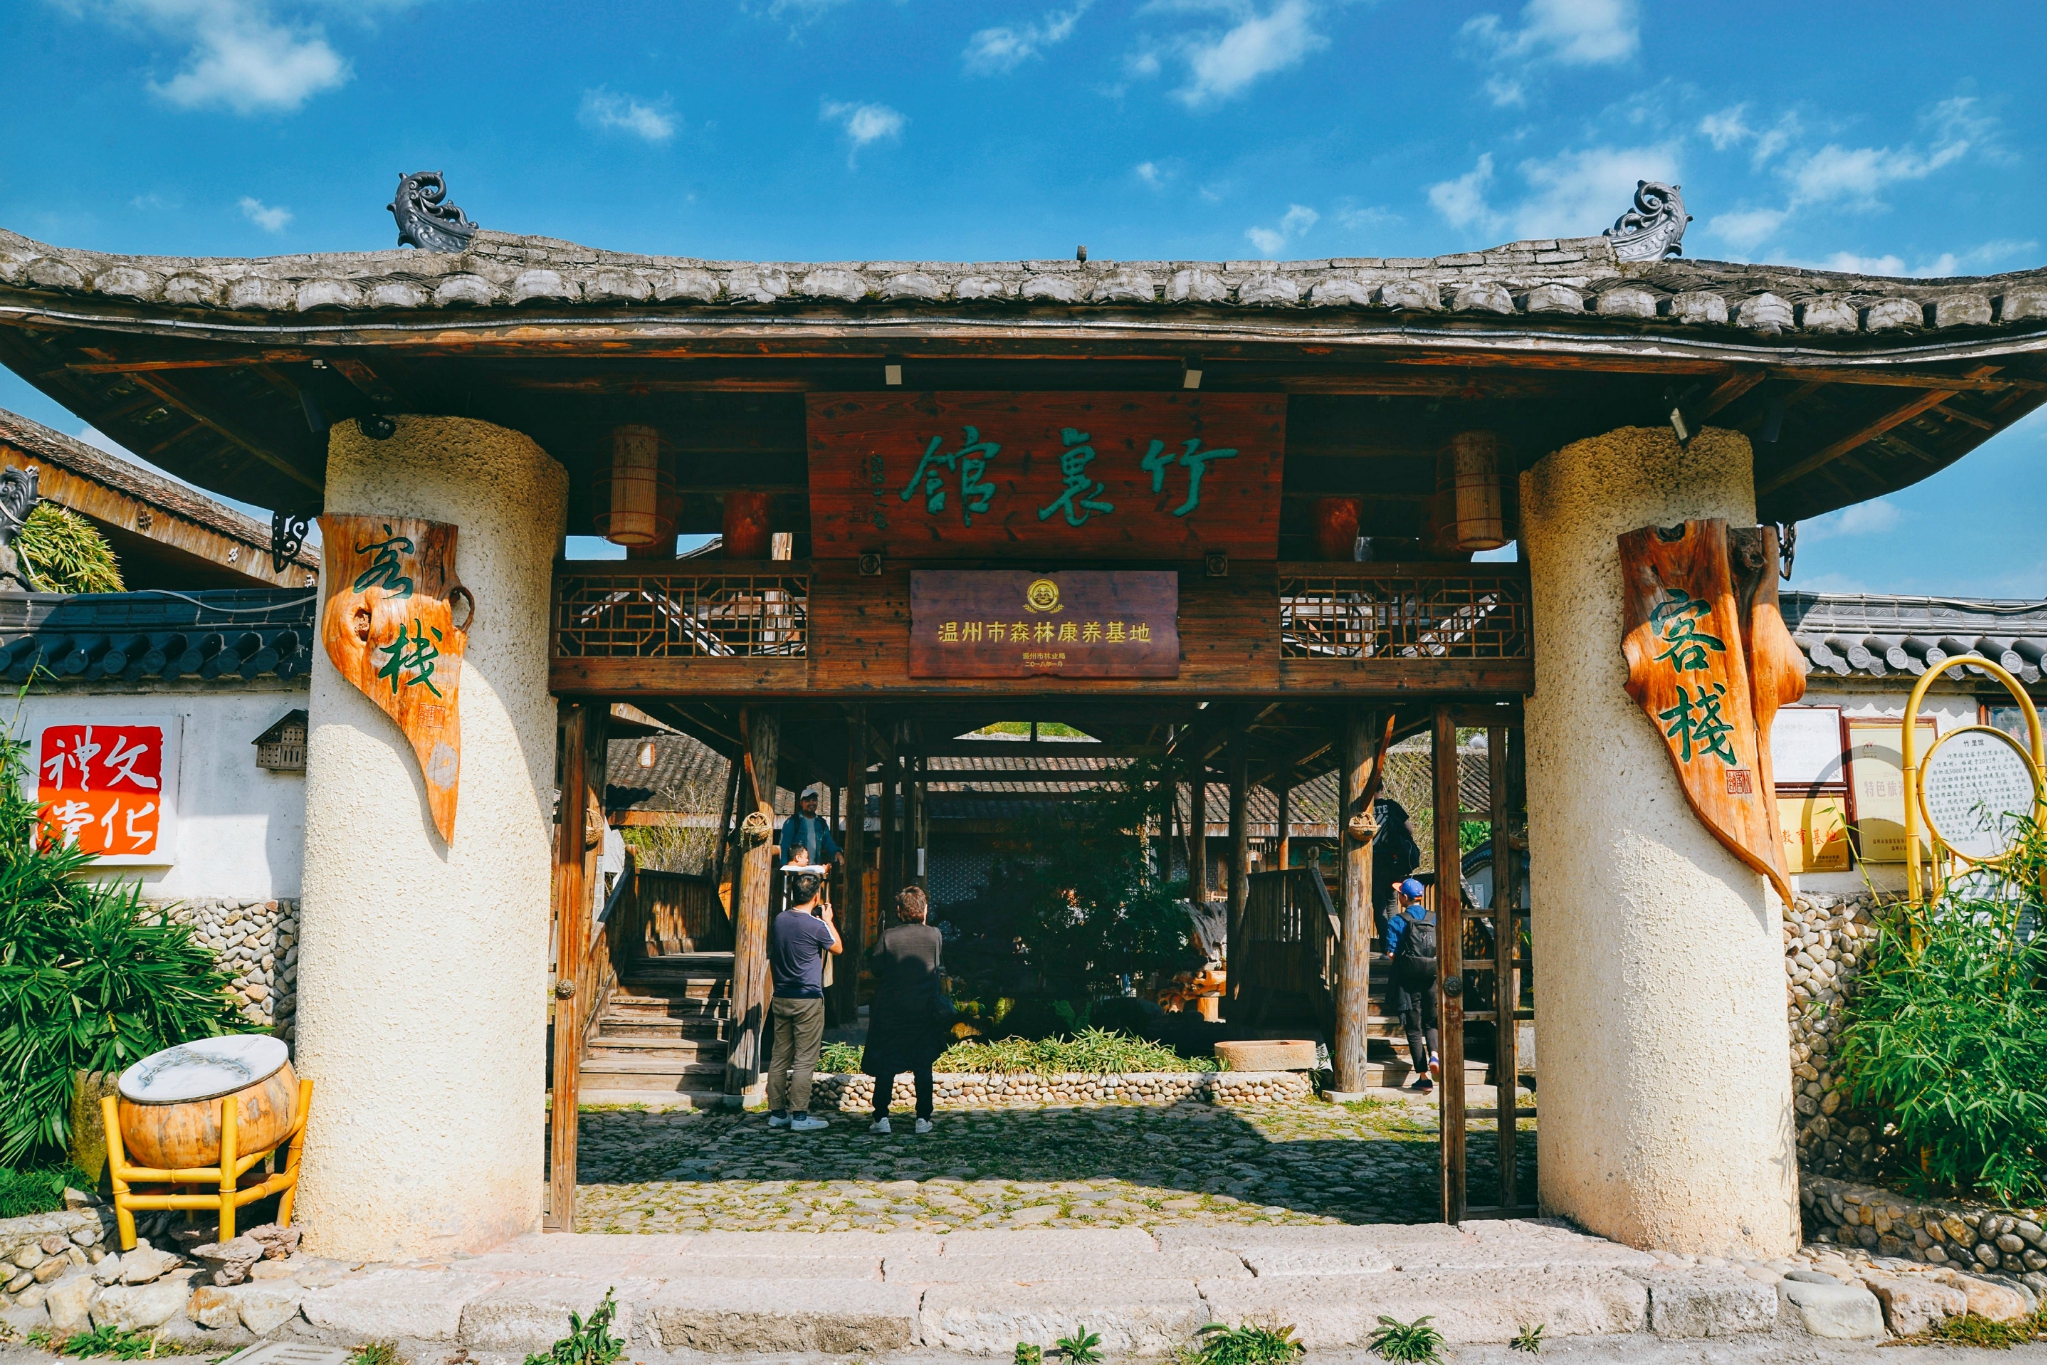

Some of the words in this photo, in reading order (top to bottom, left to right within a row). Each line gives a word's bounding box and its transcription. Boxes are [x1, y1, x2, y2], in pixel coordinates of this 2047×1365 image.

[938, 621, 1151, 643] 温州市森林康养基地
